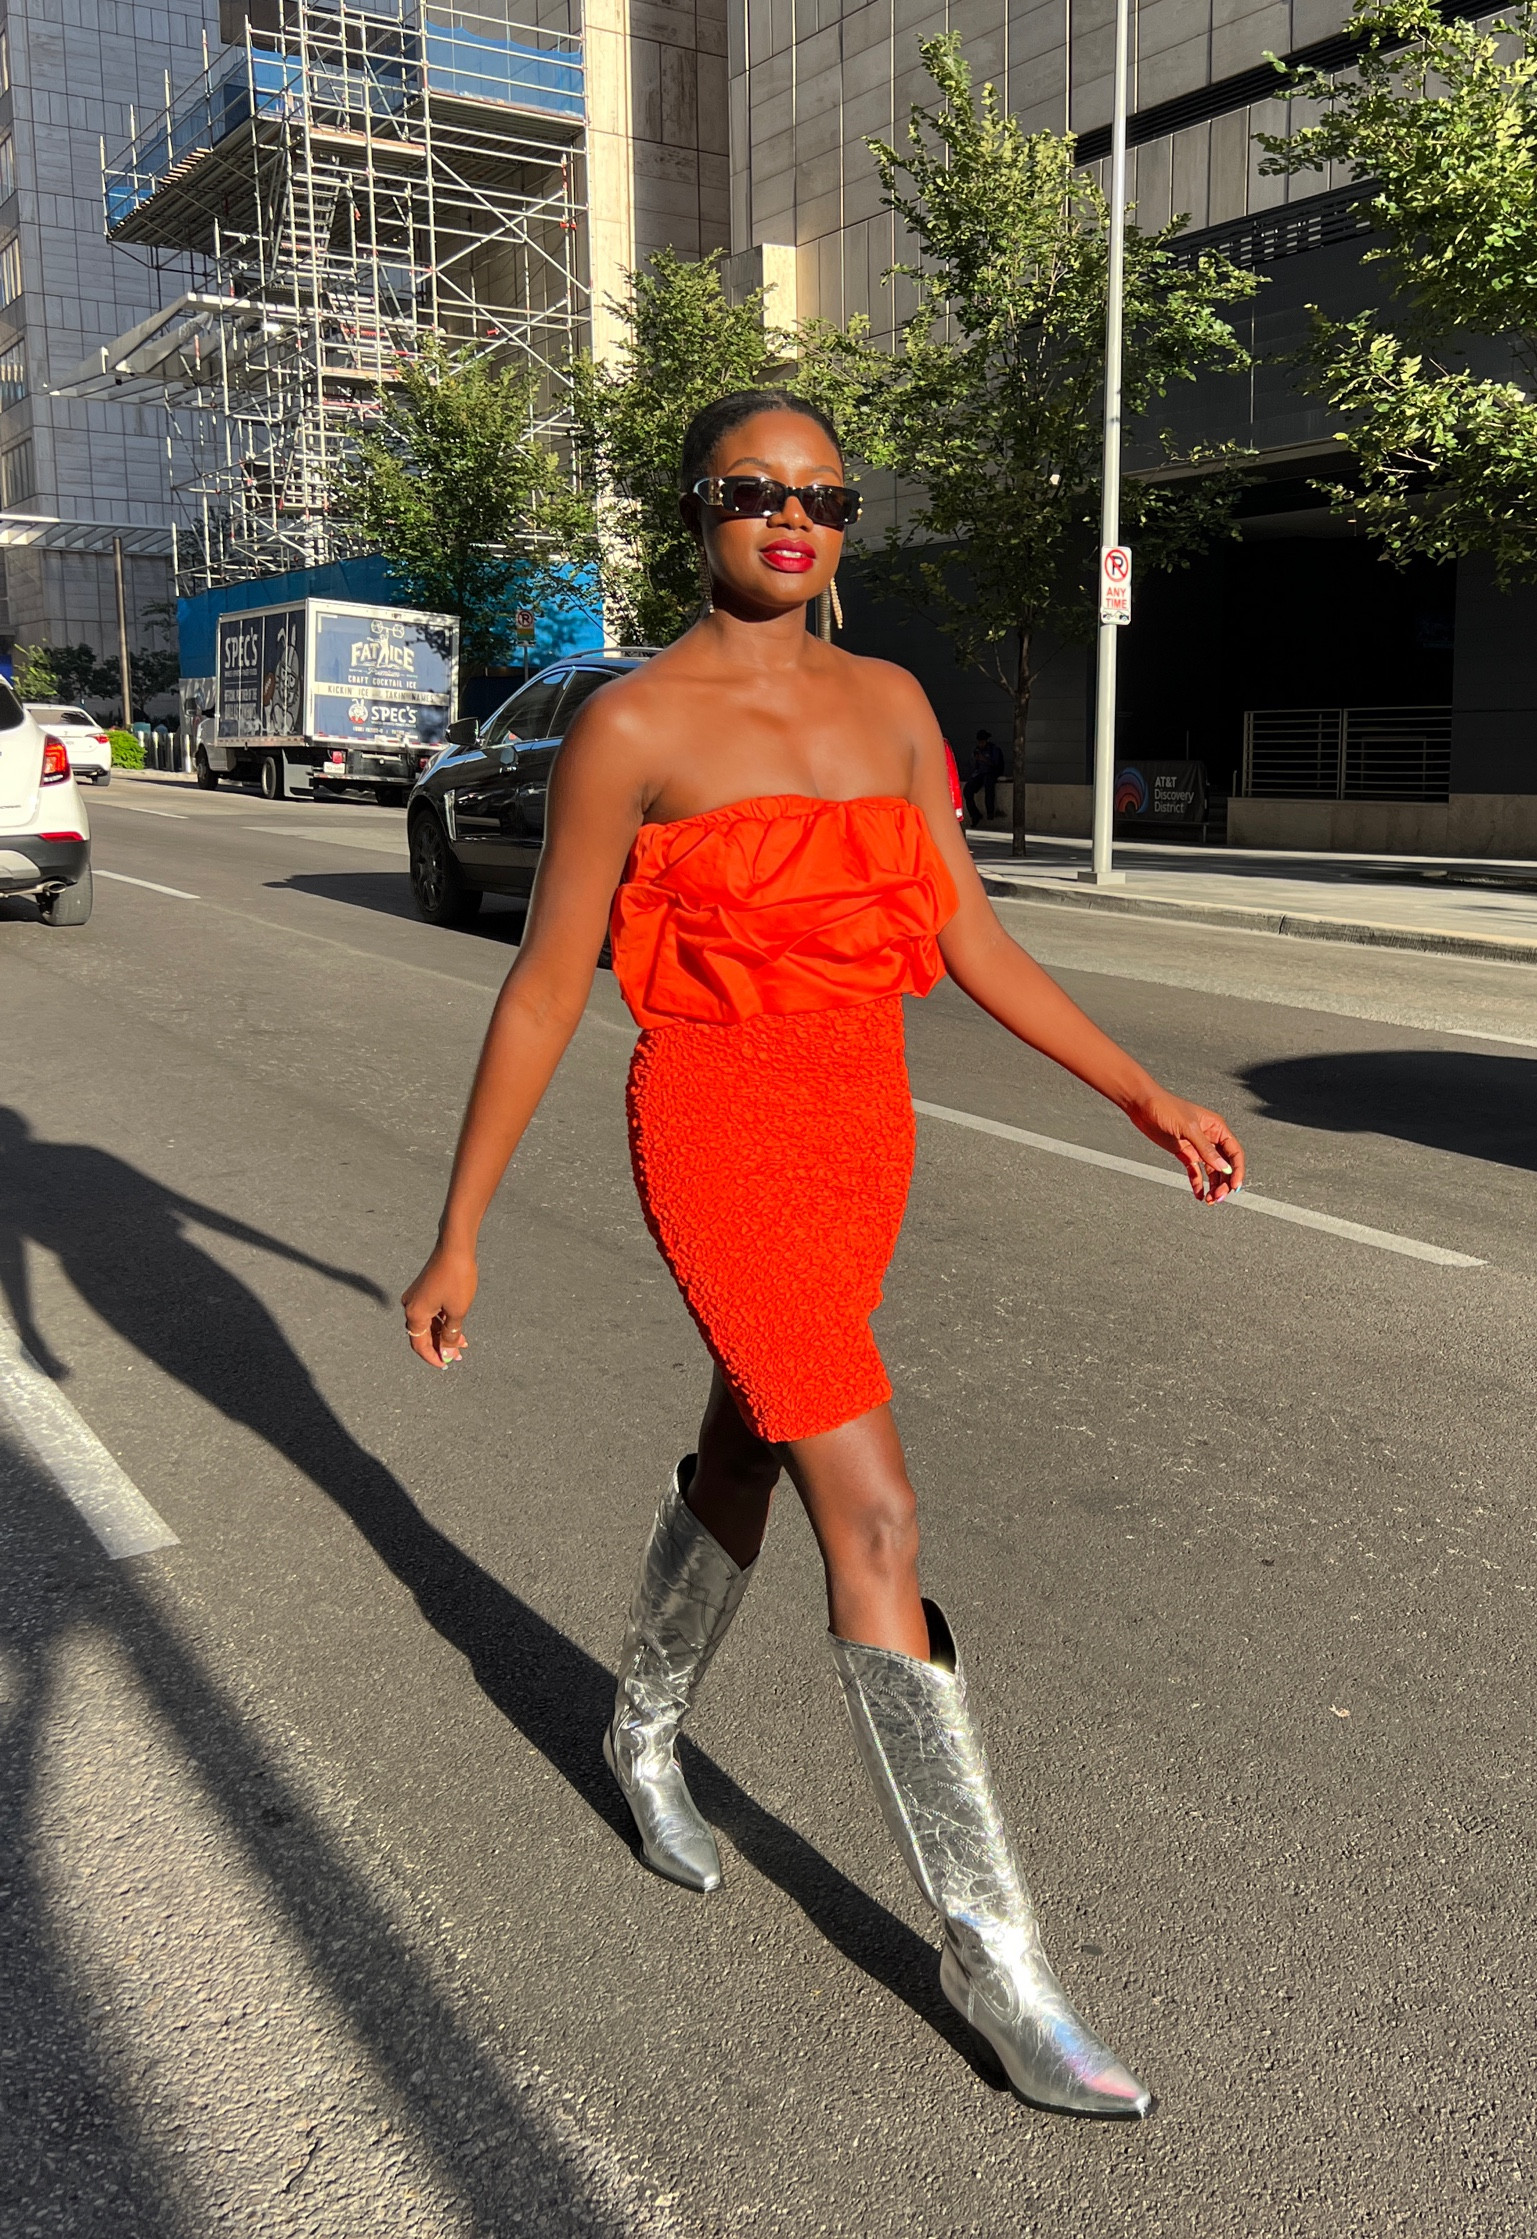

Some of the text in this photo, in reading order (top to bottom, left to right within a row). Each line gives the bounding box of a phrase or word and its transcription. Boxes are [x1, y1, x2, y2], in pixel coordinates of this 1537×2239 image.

[1106, 586, 1127, 598] ANY
[1105, 598, 1128, 610] TIME
[224, 626, 258, 669] SPEC'S
[350, 641, 415, 673] FAT ICE
[347, 674, 417, 690] CRAFT COCKTAIL ICE
[358, 687, 369, 697] ICE
[411, 693, 434, 703] NAMES
[370, 705, 418, 724] SPEC'S
[1154, 776, 1177, 788] AT&T
[1154, 789, 1195, 804] Discovery
[1154, 801, 1185, 814] District
